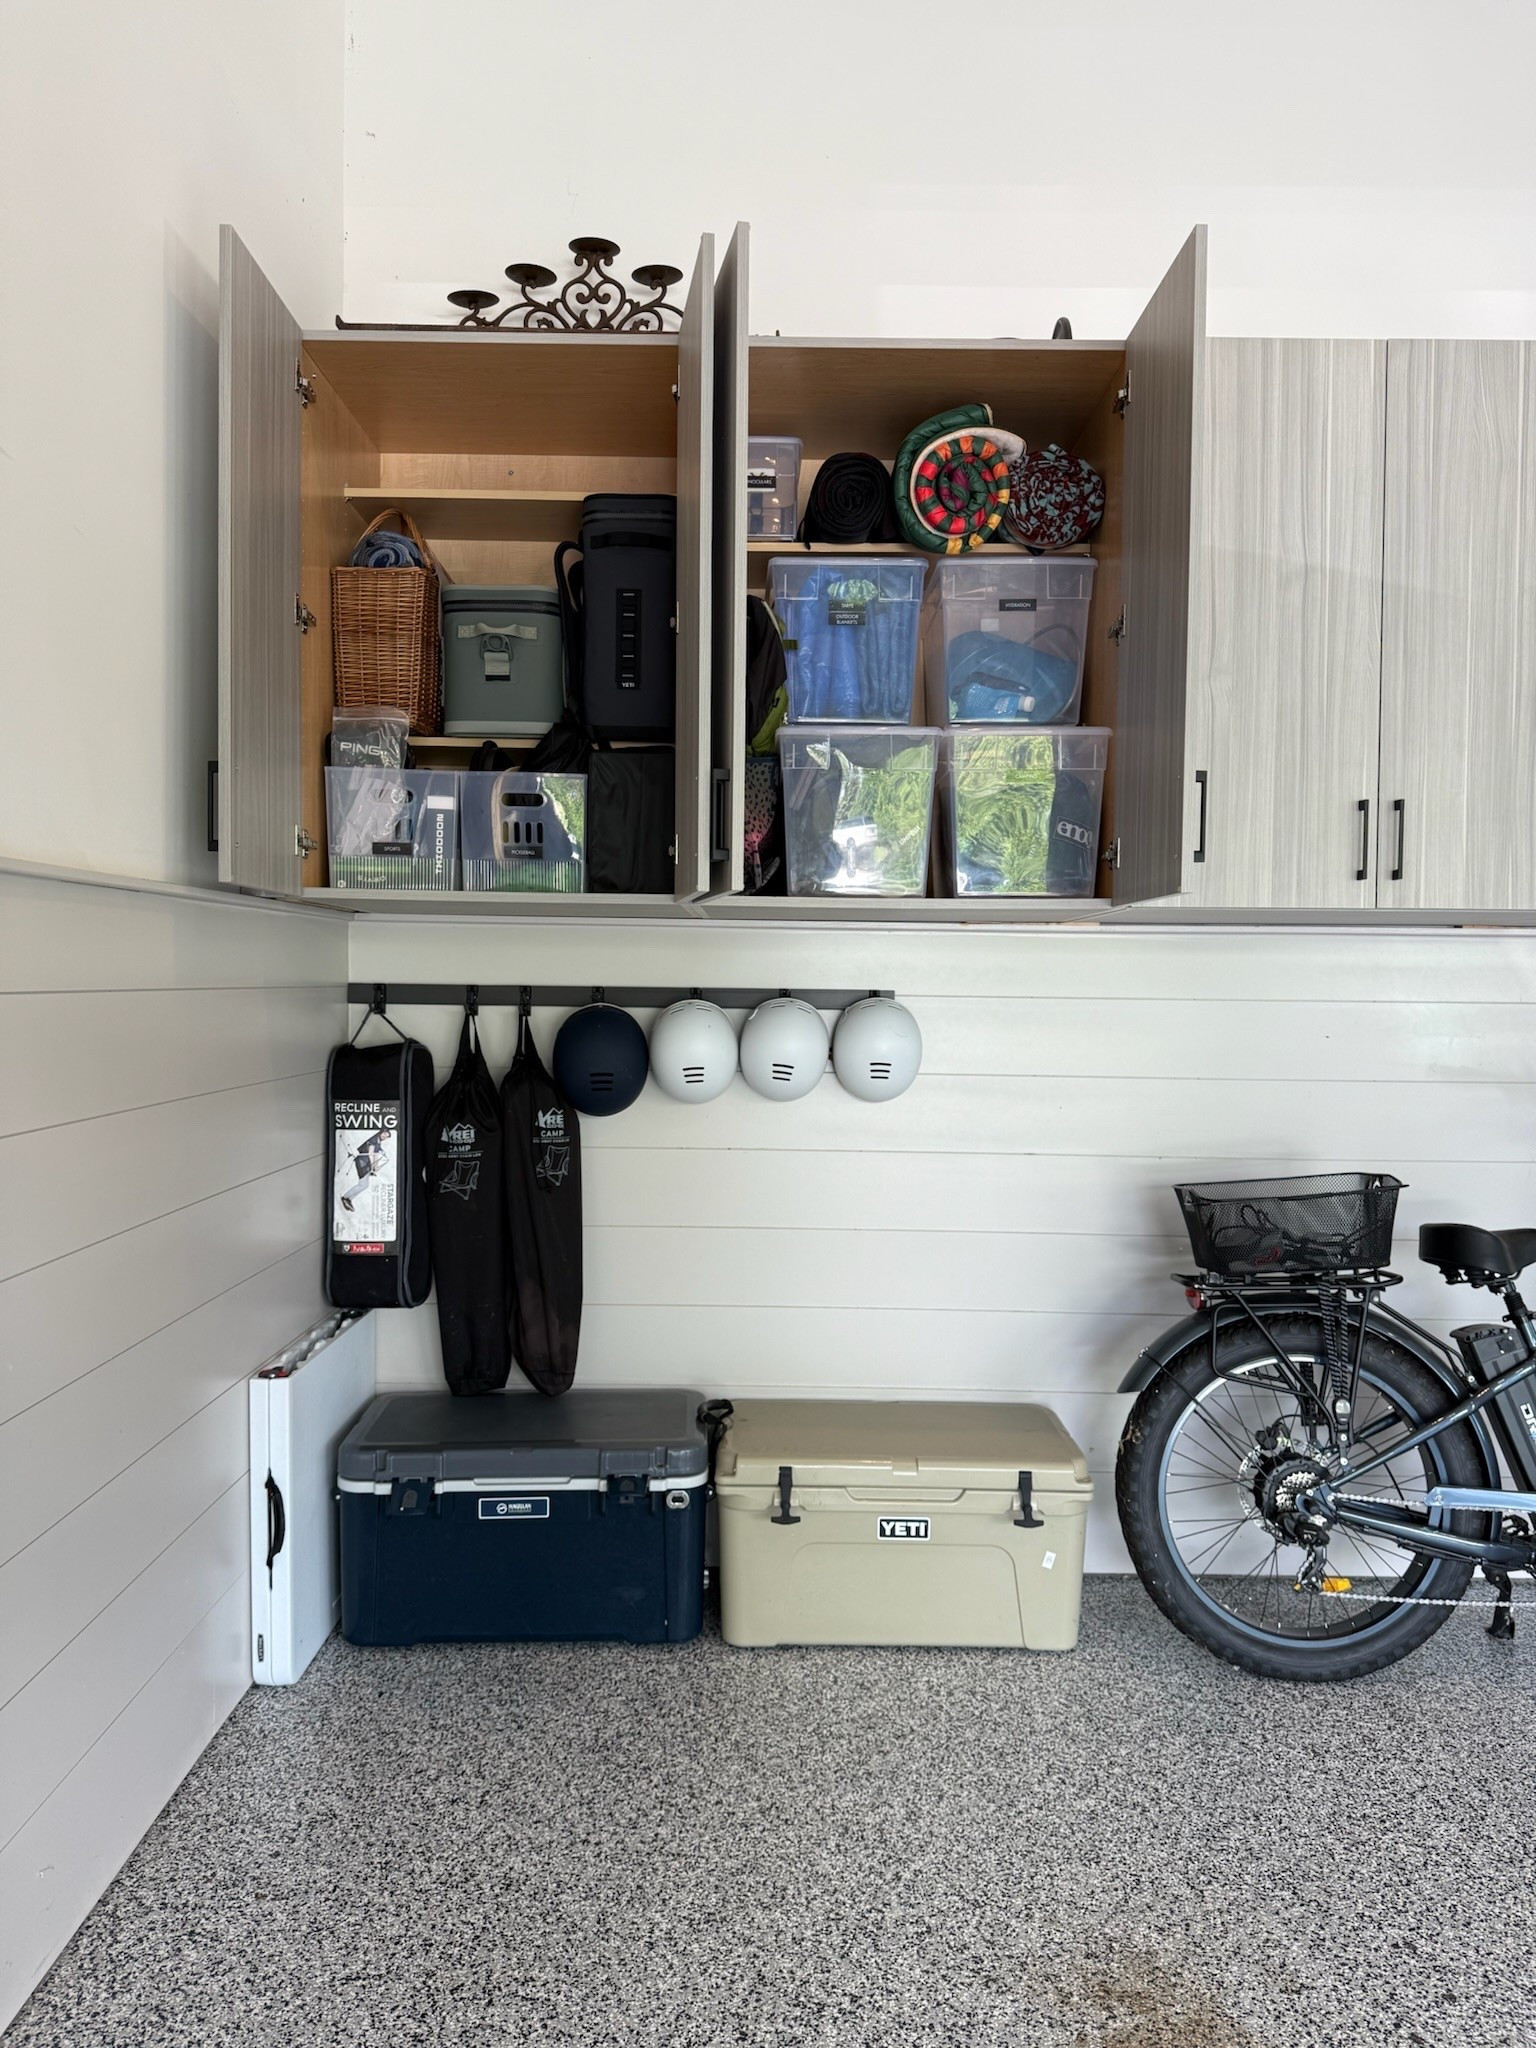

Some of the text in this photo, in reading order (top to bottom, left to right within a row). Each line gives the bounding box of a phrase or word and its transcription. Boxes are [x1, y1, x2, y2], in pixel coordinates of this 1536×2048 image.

[340, 741, 381, 757] PING
[334, 1102, 380, 1113] RECLINE
[335, 1114, 398, 1129] SWING
[547, 1114, 565, 1125] RE
[452, 1129, 475, 1141] REI
[540, 1129, 565, 1138] CAMP
[386, 1183, 395, 1225] STARGAZE
[880, 1520, 926, 1537] YETI
